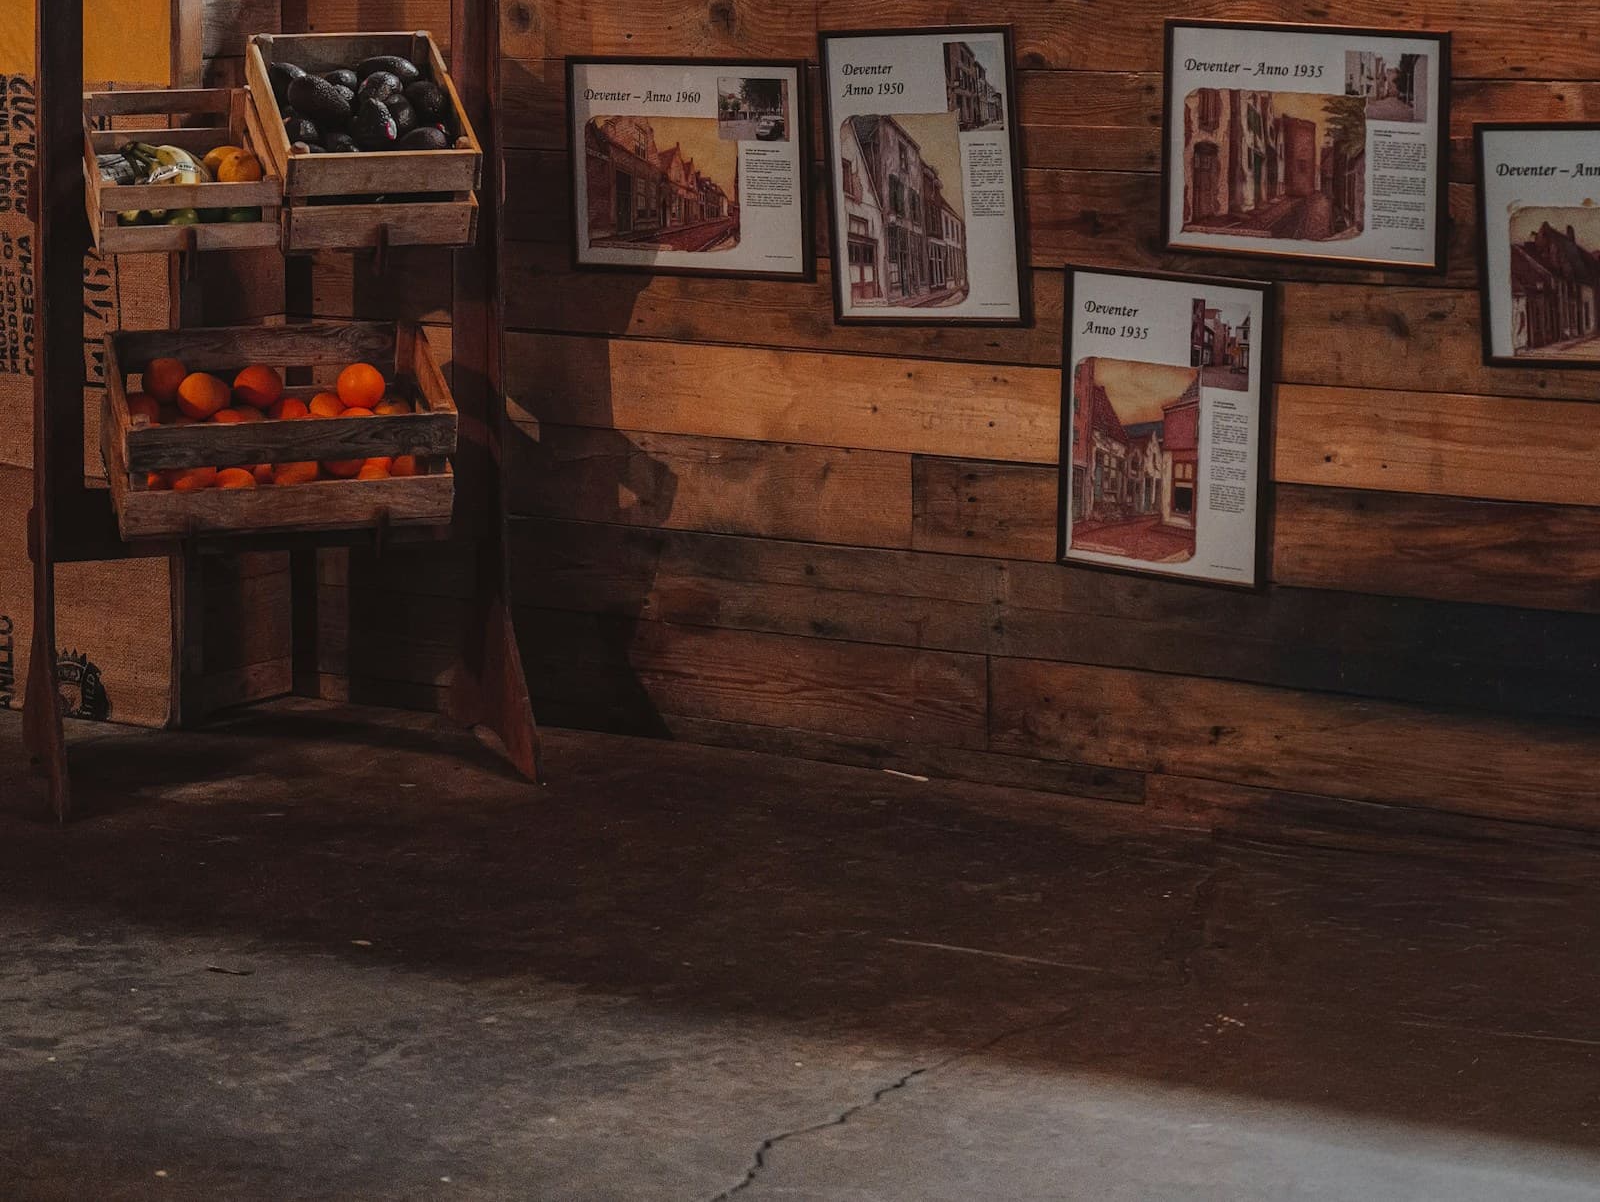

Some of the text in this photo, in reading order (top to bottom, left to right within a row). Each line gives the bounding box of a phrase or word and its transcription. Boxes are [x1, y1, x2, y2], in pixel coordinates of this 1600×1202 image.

[842, 63, 893, 76] Deventer
[1184, 57, 1241, 74] Deventer
[1253, 61, 1289, 77] Anno
[1294, 65, 1324, 78] 1935
[584, 88, 631, 103] Deventer
[642, 90, 672, 104] Anno
[675, 91, 701, 104] 1960
[842, 82, 904, 98] Anno 1950
[1496, 163, 1557, 177] Deventer
[3, 231, 13, 260] OF
[1084, 300, 1139, 318] Deventer
[1082, 321, 1149, 341] Anno 1935
